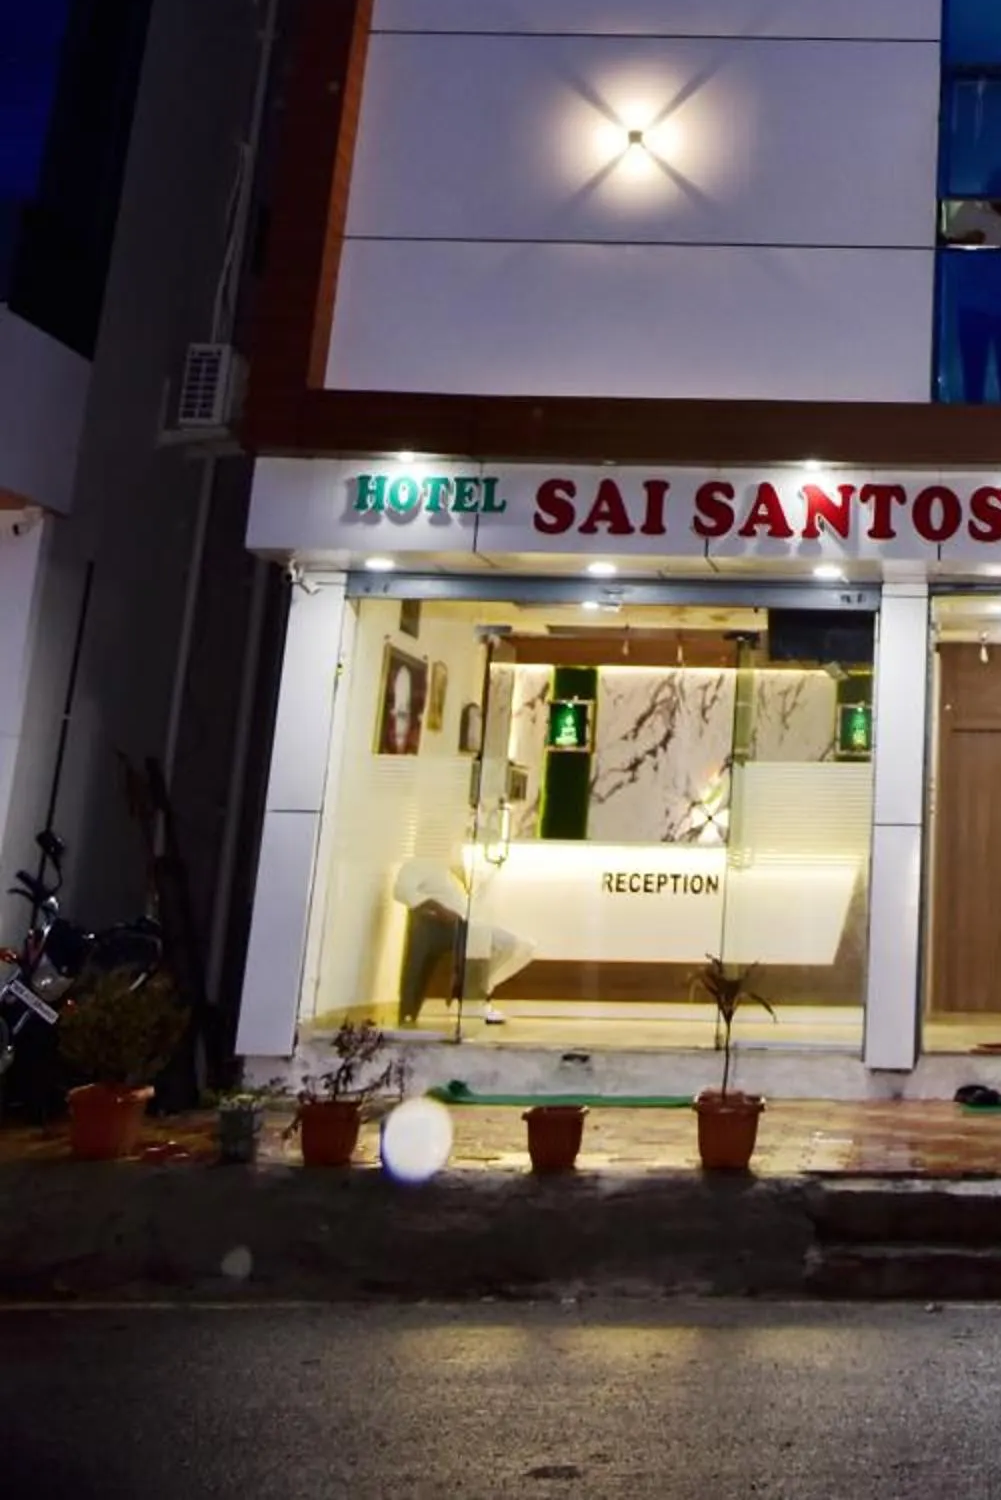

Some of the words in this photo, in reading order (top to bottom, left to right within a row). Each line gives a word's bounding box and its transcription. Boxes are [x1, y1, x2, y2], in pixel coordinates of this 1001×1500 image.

[354, 474, 507, 514] HOTEL
[533, 478, 670, 536] SAI
[602, 872, 718, 894] RECEPTION
